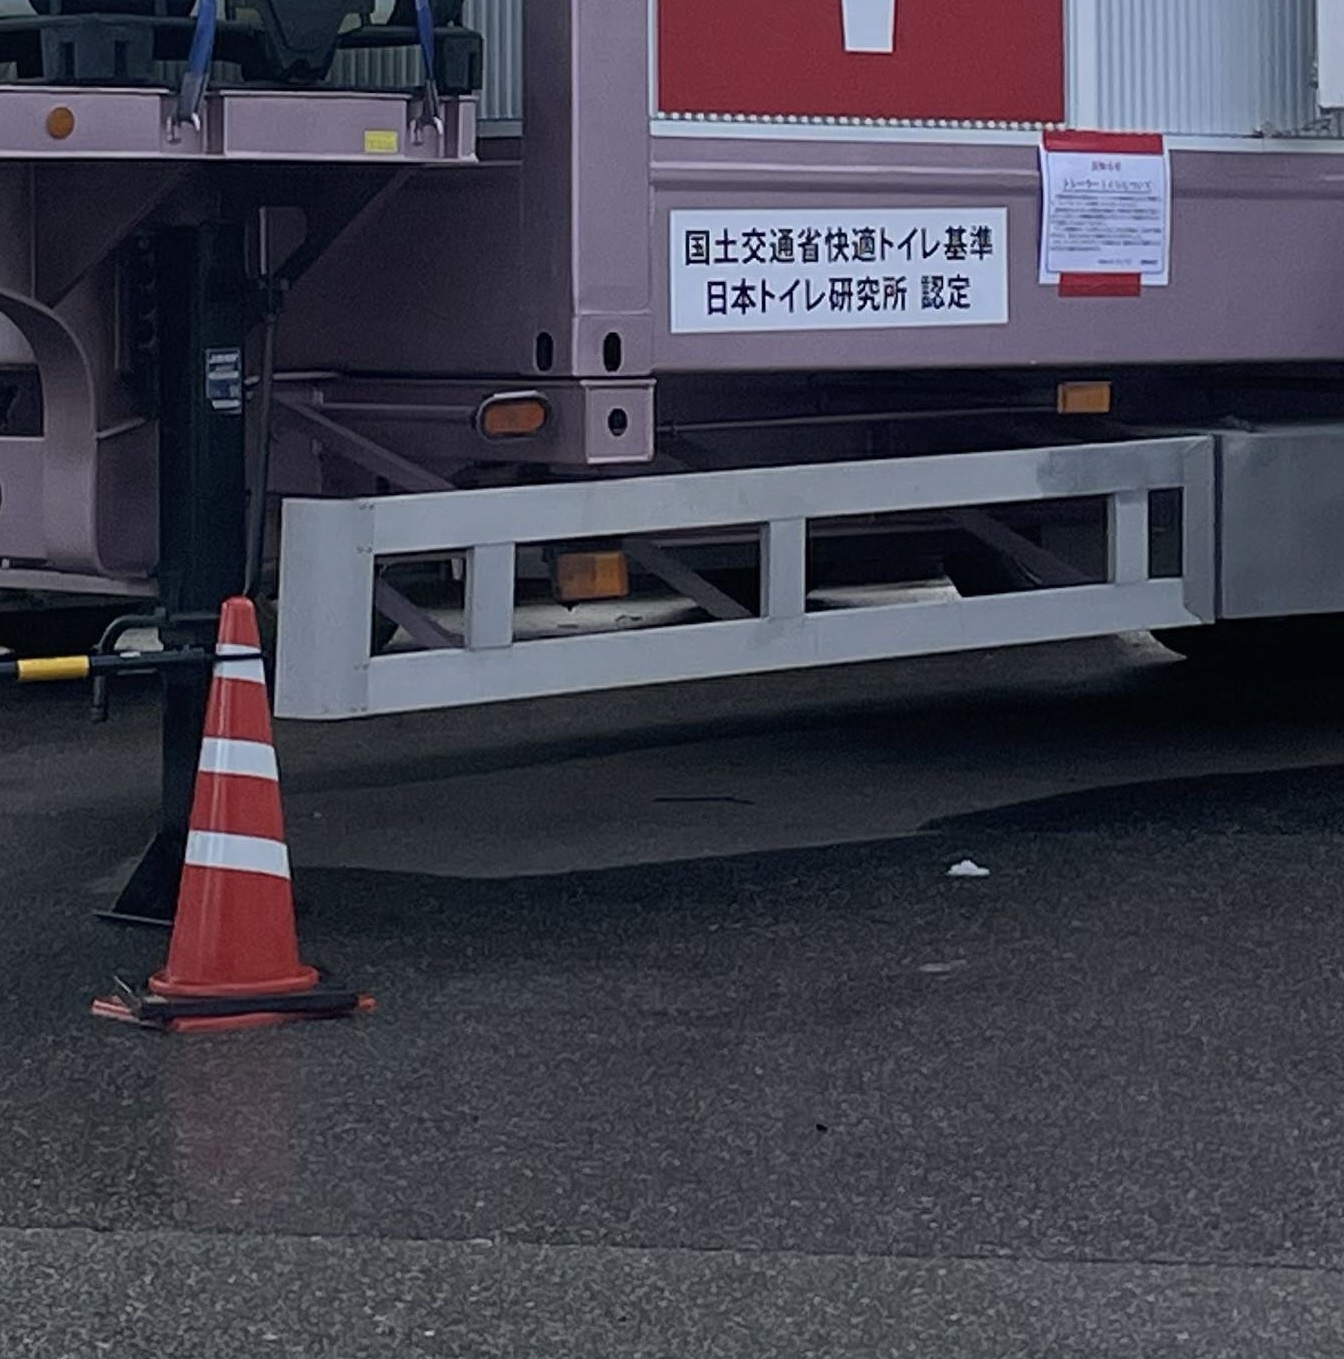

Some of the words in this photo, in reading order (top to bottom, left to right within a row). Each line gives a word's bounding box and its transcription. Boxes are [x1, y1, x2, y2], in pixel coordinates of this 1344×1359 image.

[685, 225, 993, 265] 国土交通省快適トイレ基準
[707, 276, 907, 315] 日本トイレ研究所
[921, 273, 971, 311] 認定
